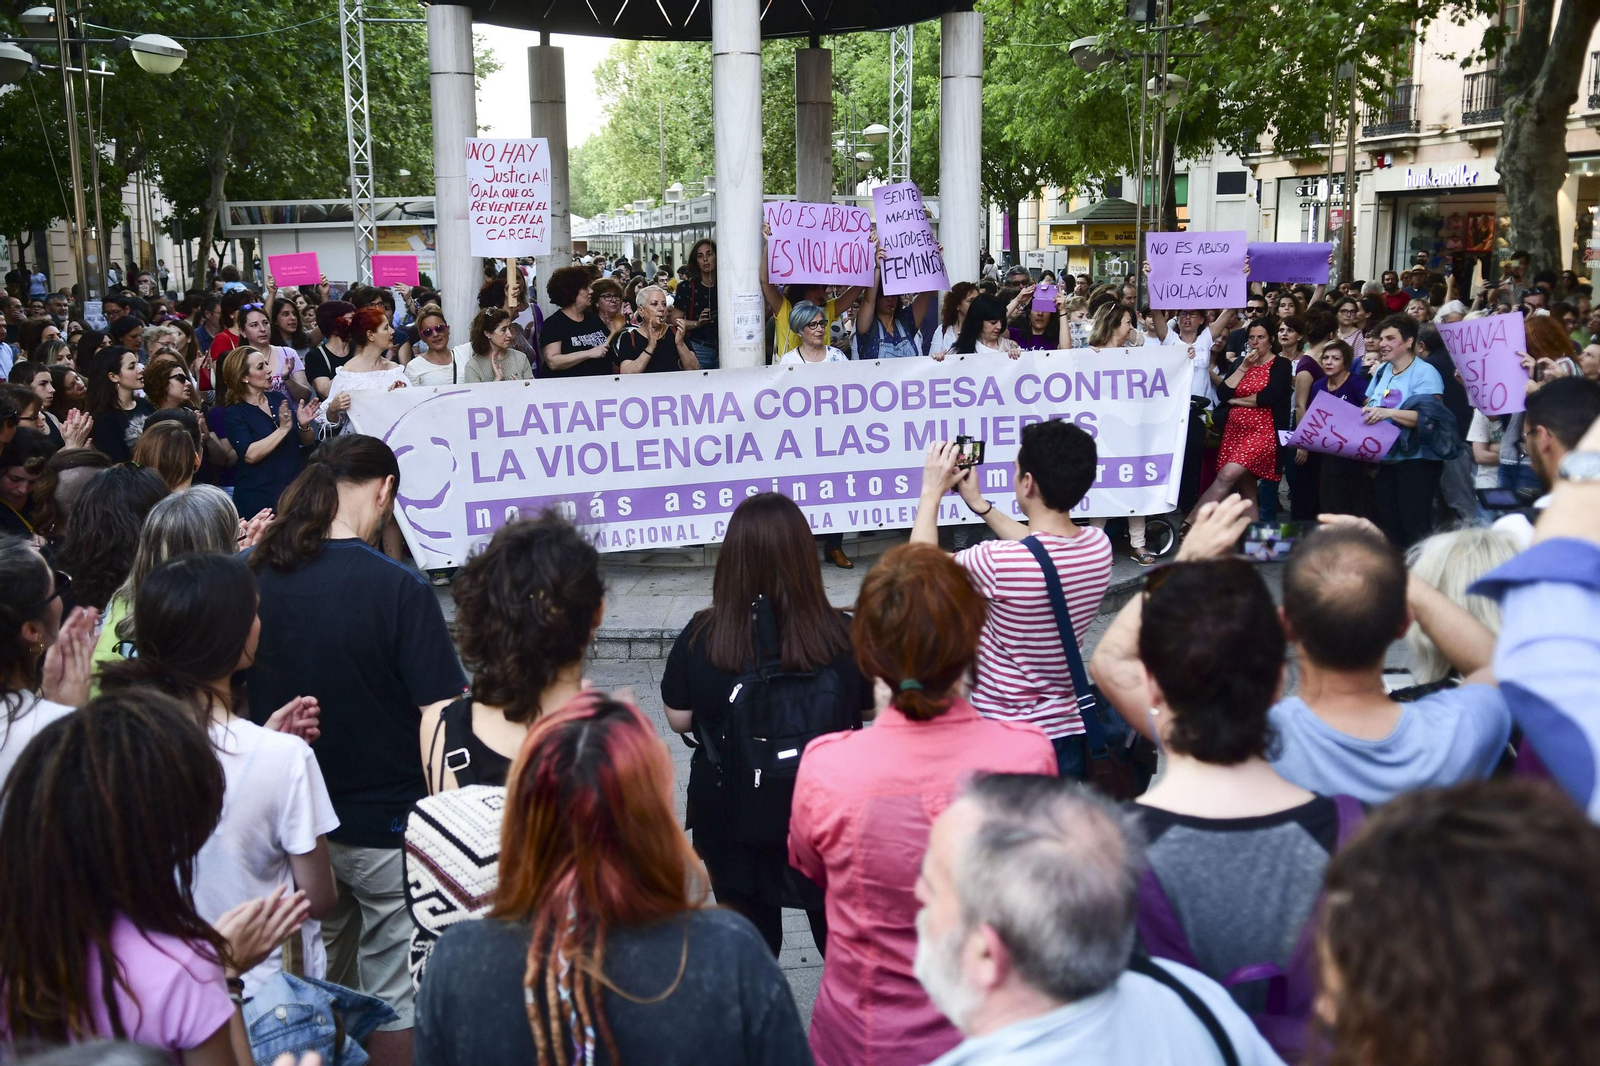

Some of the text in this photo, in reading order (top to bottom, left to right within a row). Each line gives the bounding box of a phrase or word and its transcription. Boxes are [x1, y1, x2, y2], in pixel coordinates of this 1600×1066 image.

[499, 142, 538, 163] HAY
[1405, 164, 1479, 188] hunkemöller
[502, 188, 519, 199] QUE
[521, 188, 535, 198] OS
[470, 200, 548, 213] REVIENTEN EL
[476, 213, 543, 226] CULO EN LA
[767, 202, 872, 233] NO ES ABUSO
[771, 235, 871, 277] ES VIOLACIÓN
[1150, 241, 1230, 255] NO ES ABUSO
[1181, 263, 1203, 276] ES
[467, 367, 1170, 441] PLATAFORMA CORDOBESA CONTRA
[471, 448, 527, 484] LA
[536, 432, 764, 479] VIOLENCIA
[774, 428, 803, 461] A
[815, 421, 891, 458] LAS
[554, 491, 633, 521] más
[810, 512, 833, 529] LA
